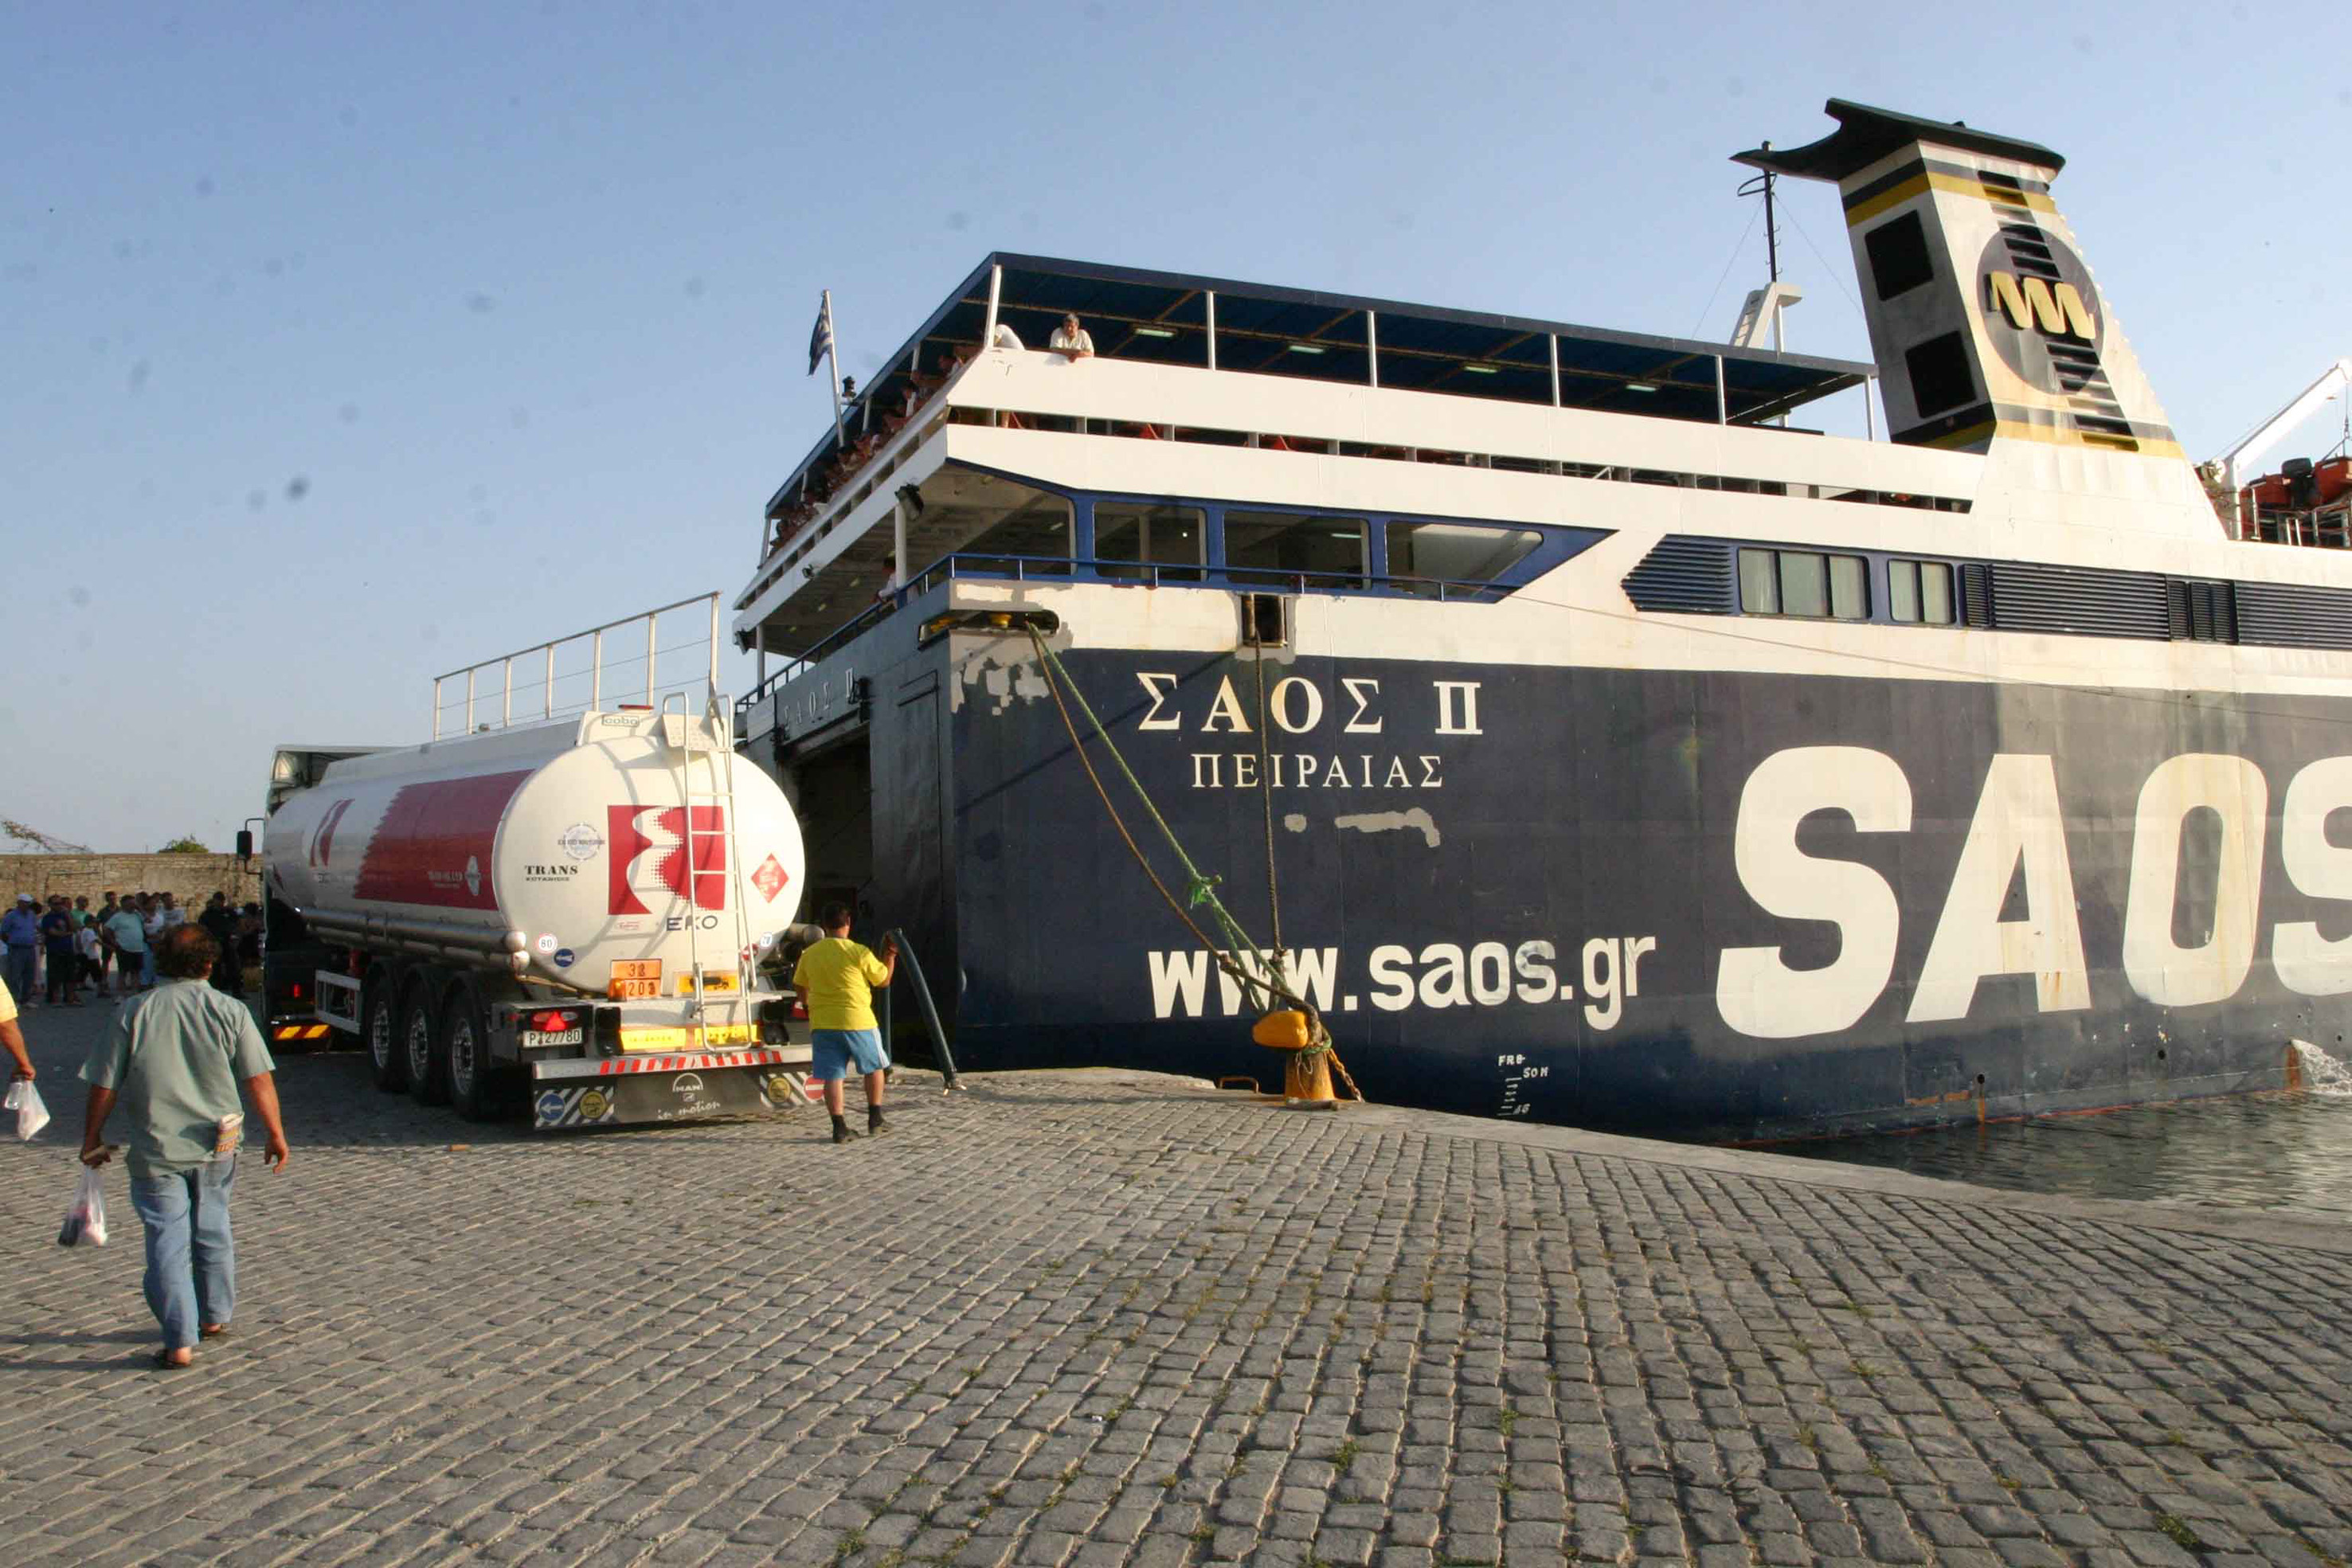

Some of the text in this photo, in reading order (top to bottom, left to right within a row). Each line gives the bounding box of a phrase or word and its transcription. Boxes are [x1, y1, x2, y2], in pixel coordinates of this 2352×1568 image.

[1136, 671, 1383, 734] ΣΑΟΣ
[1191, 753, 1443, 788] ΠΕΙΡΑΙΑΣ
[524, 865, 578, 875] TRANS
[666, 915, 718, 932] EKO
[1147, 935, 1657, 1031] www.saos.gr
[678, 1100, 721, 1116] motion
